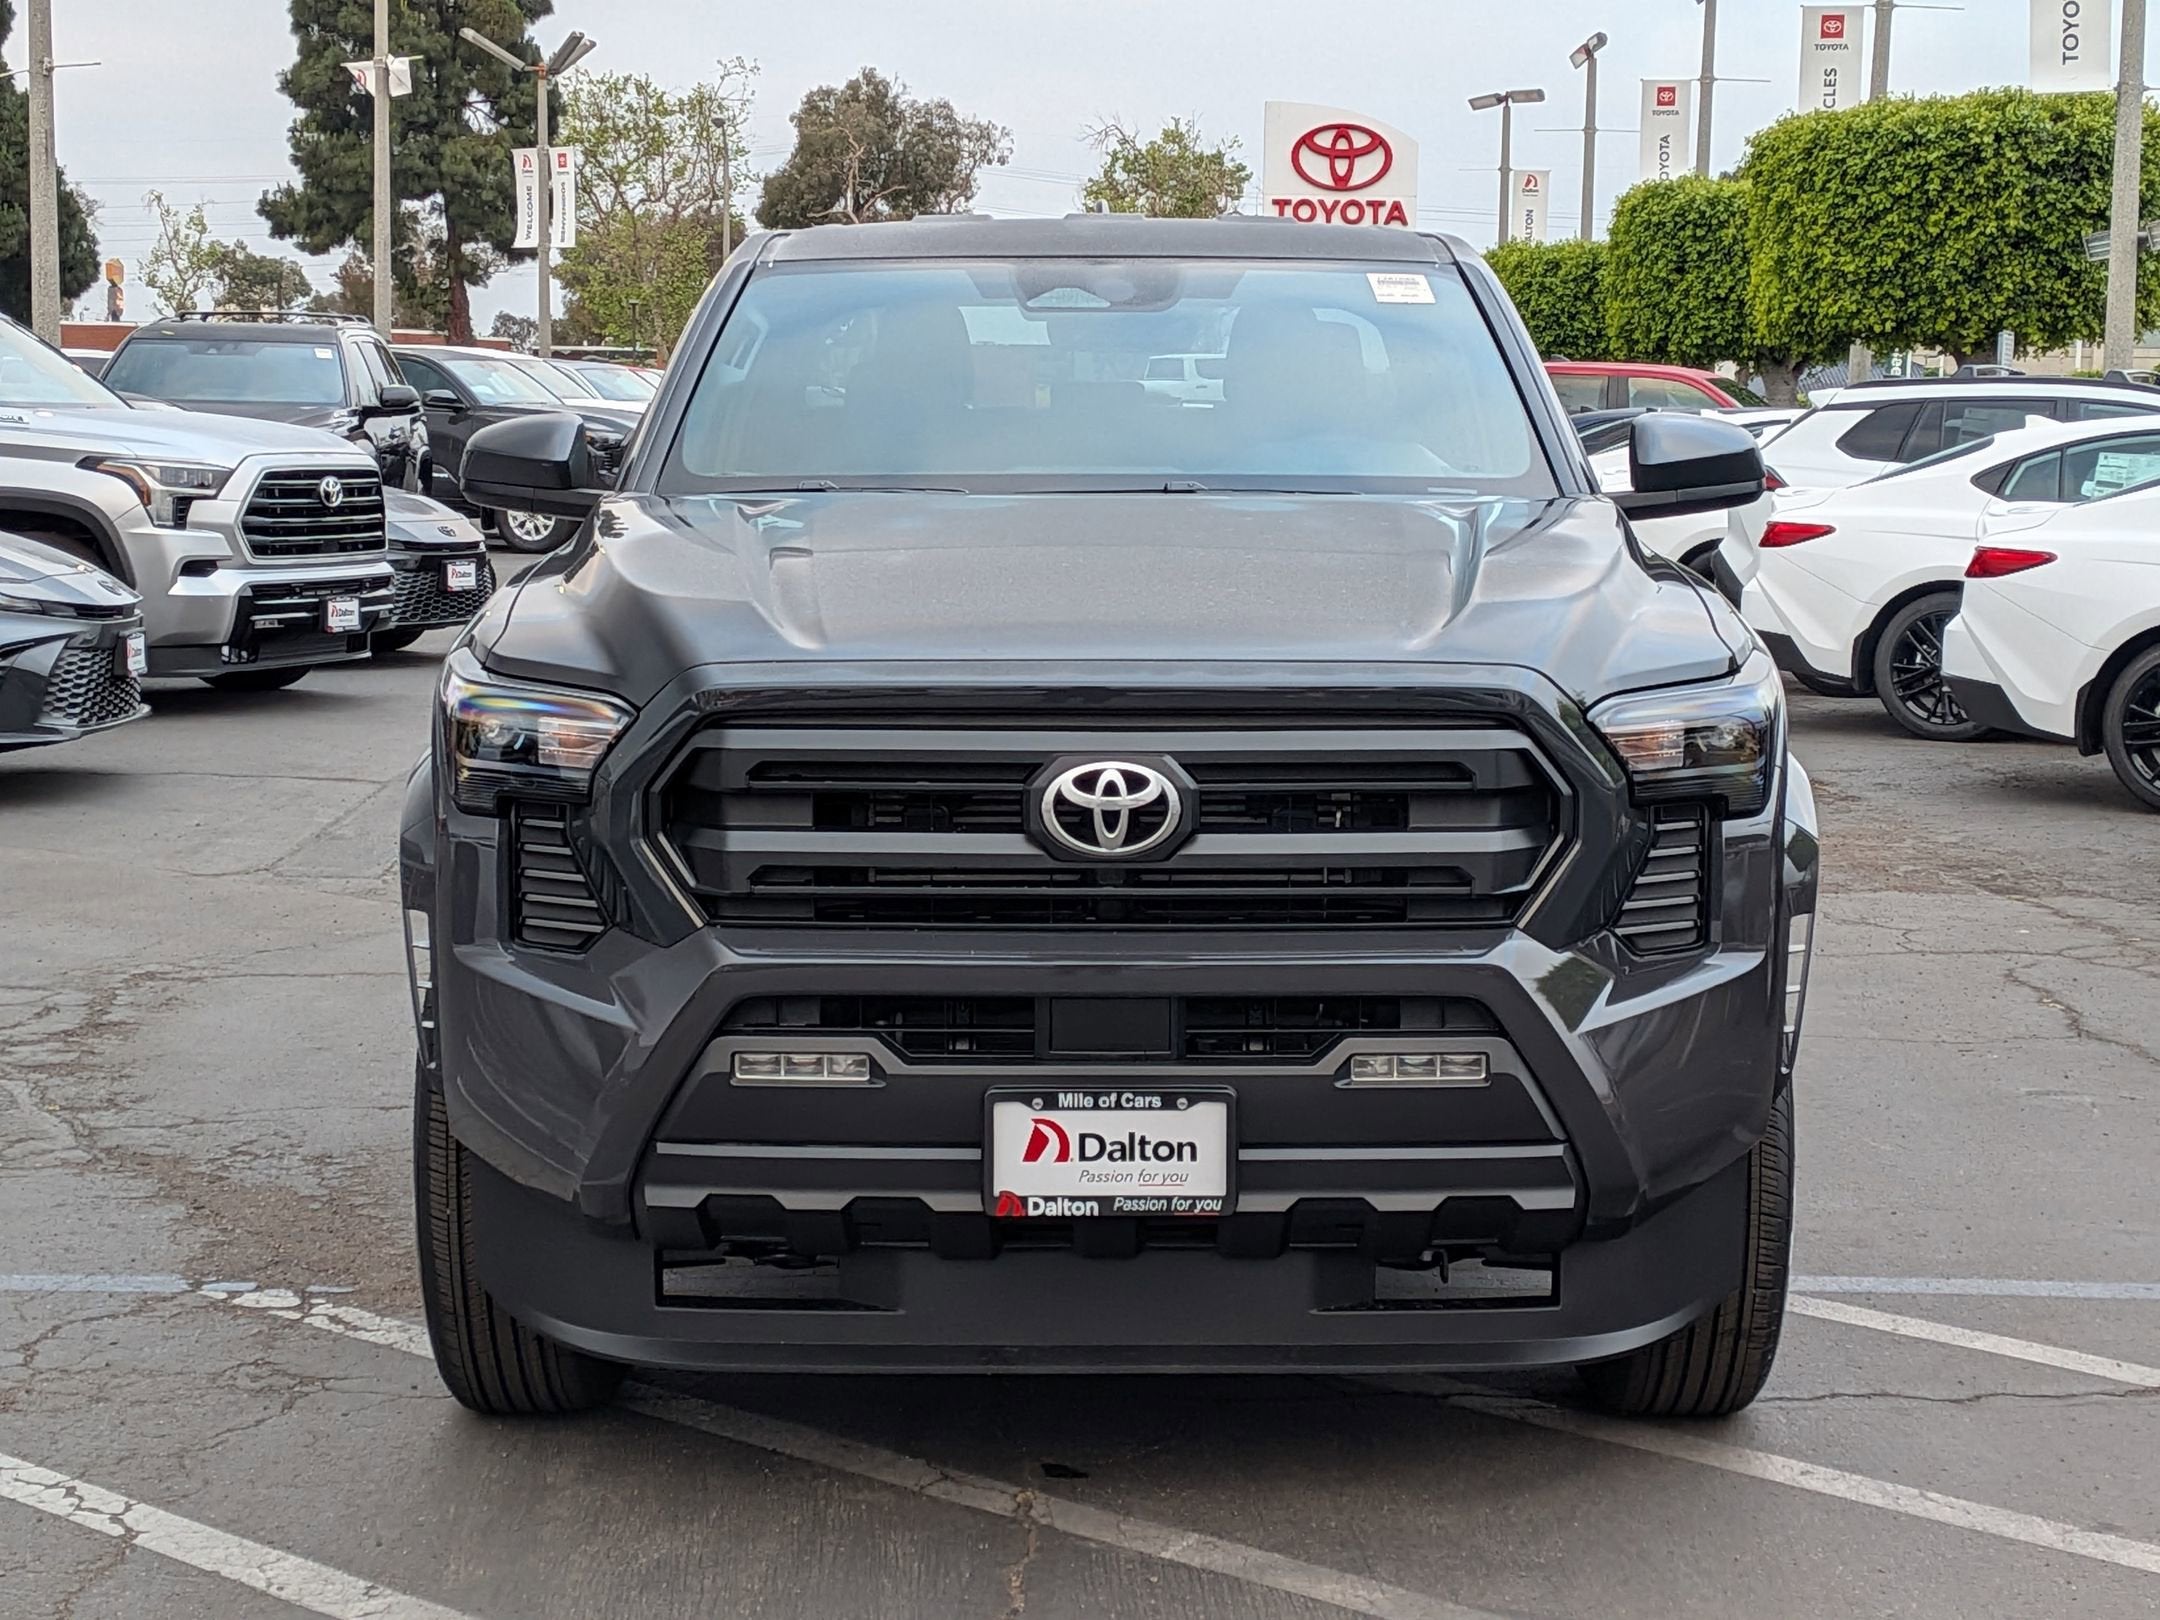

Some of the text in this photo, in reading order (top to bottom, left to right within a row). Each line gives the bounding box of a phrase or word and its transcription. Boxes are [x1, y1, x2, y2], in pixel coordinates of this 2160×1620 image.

[2062, 0, 2080, 65] TOYO
[1814, 43, 1849, 51] TOYOTA
[1823, 67, 1837, 112] CLES
[525, 185, 534, 240] WELCOME
[1271, 198, 1408, 226] TOYOTA
[1058, 1093, 1162, 1108] Mile of Cars
[1078, 1131, 1198, 1162] Dalton
[1078, 1168, 1189, 1185] Passion for you
[1027, 1197, 1099, 1217] Dalton
[1113, 1196, 1222, 1214] Passion for you
